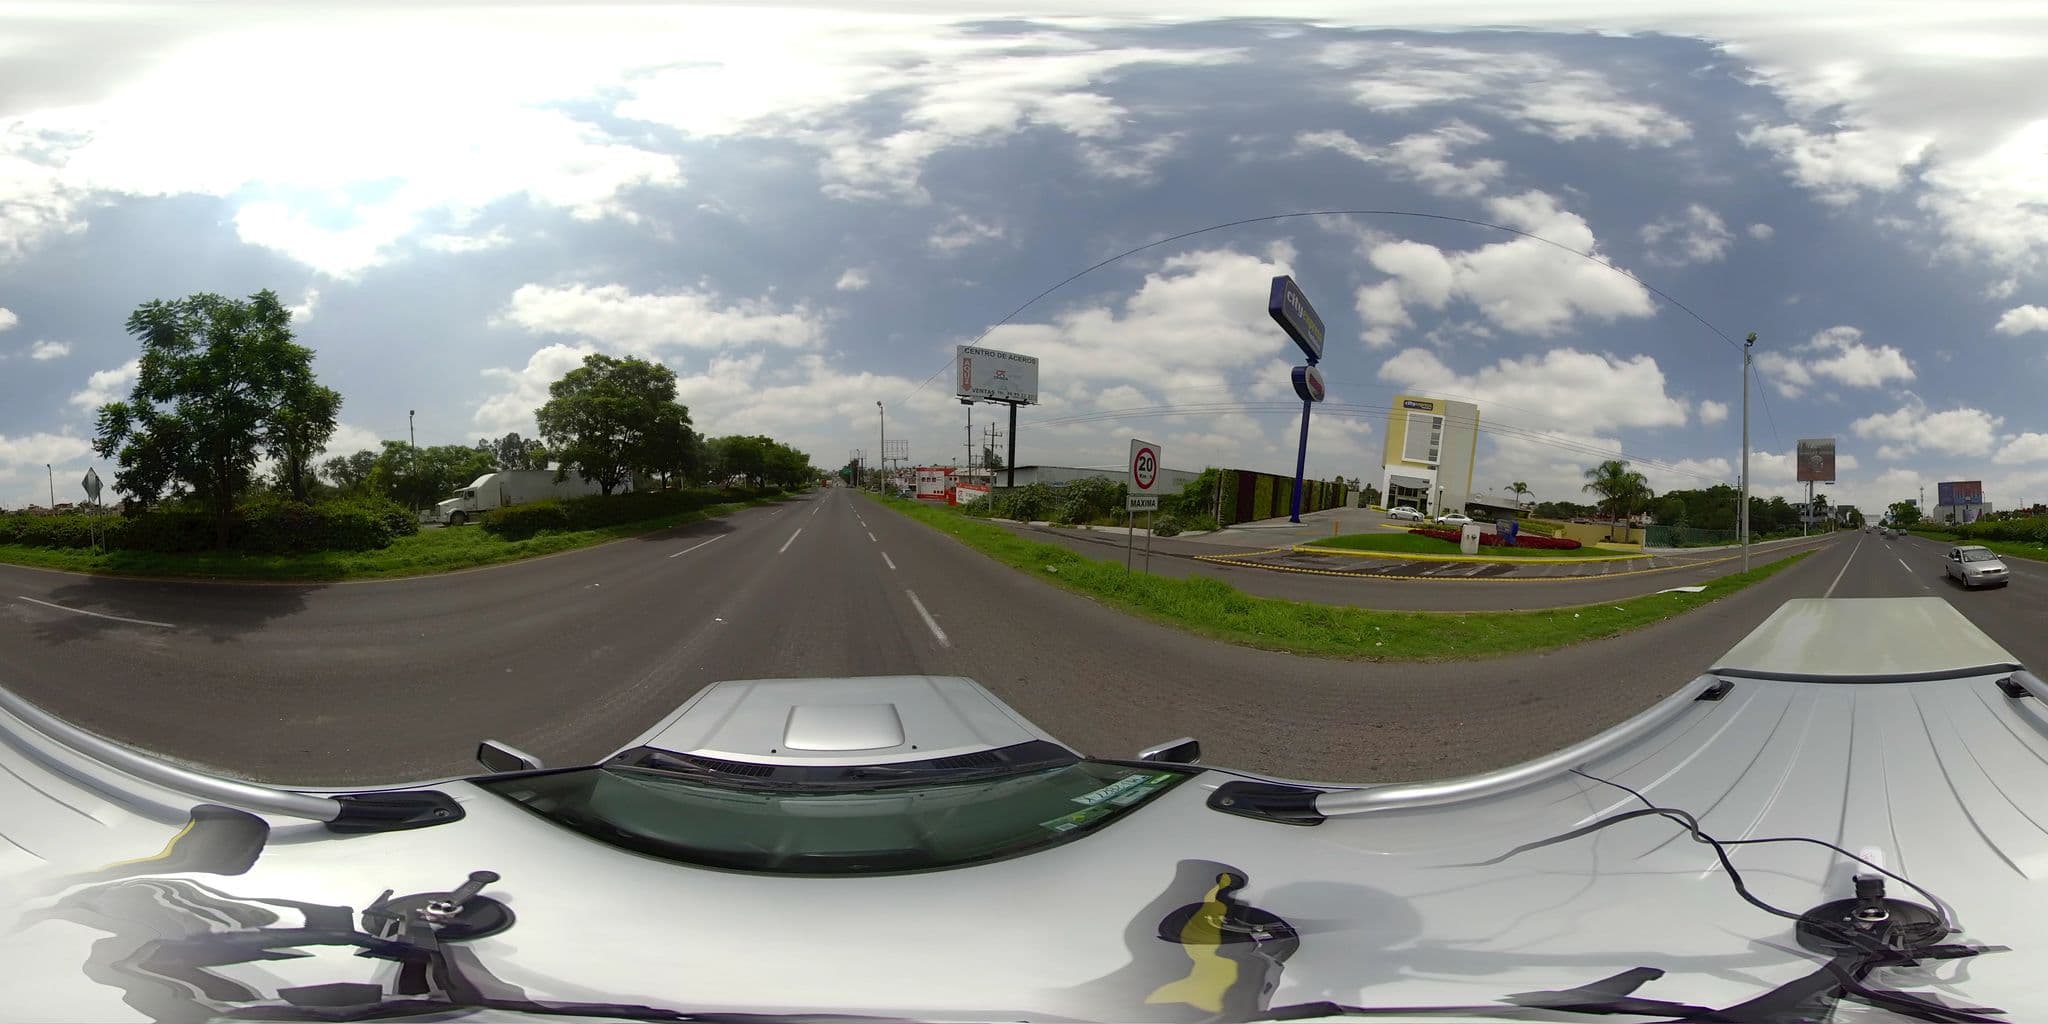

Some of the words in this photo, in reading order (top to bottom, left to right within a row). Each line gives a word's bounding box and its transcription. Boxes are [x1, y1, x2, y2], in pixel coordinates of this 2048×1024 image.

[964, 347, 995, 357] CENTRO
[1008, 354, 1036, 365] ACEROS
[1139, 456, 1153, 472] 20
